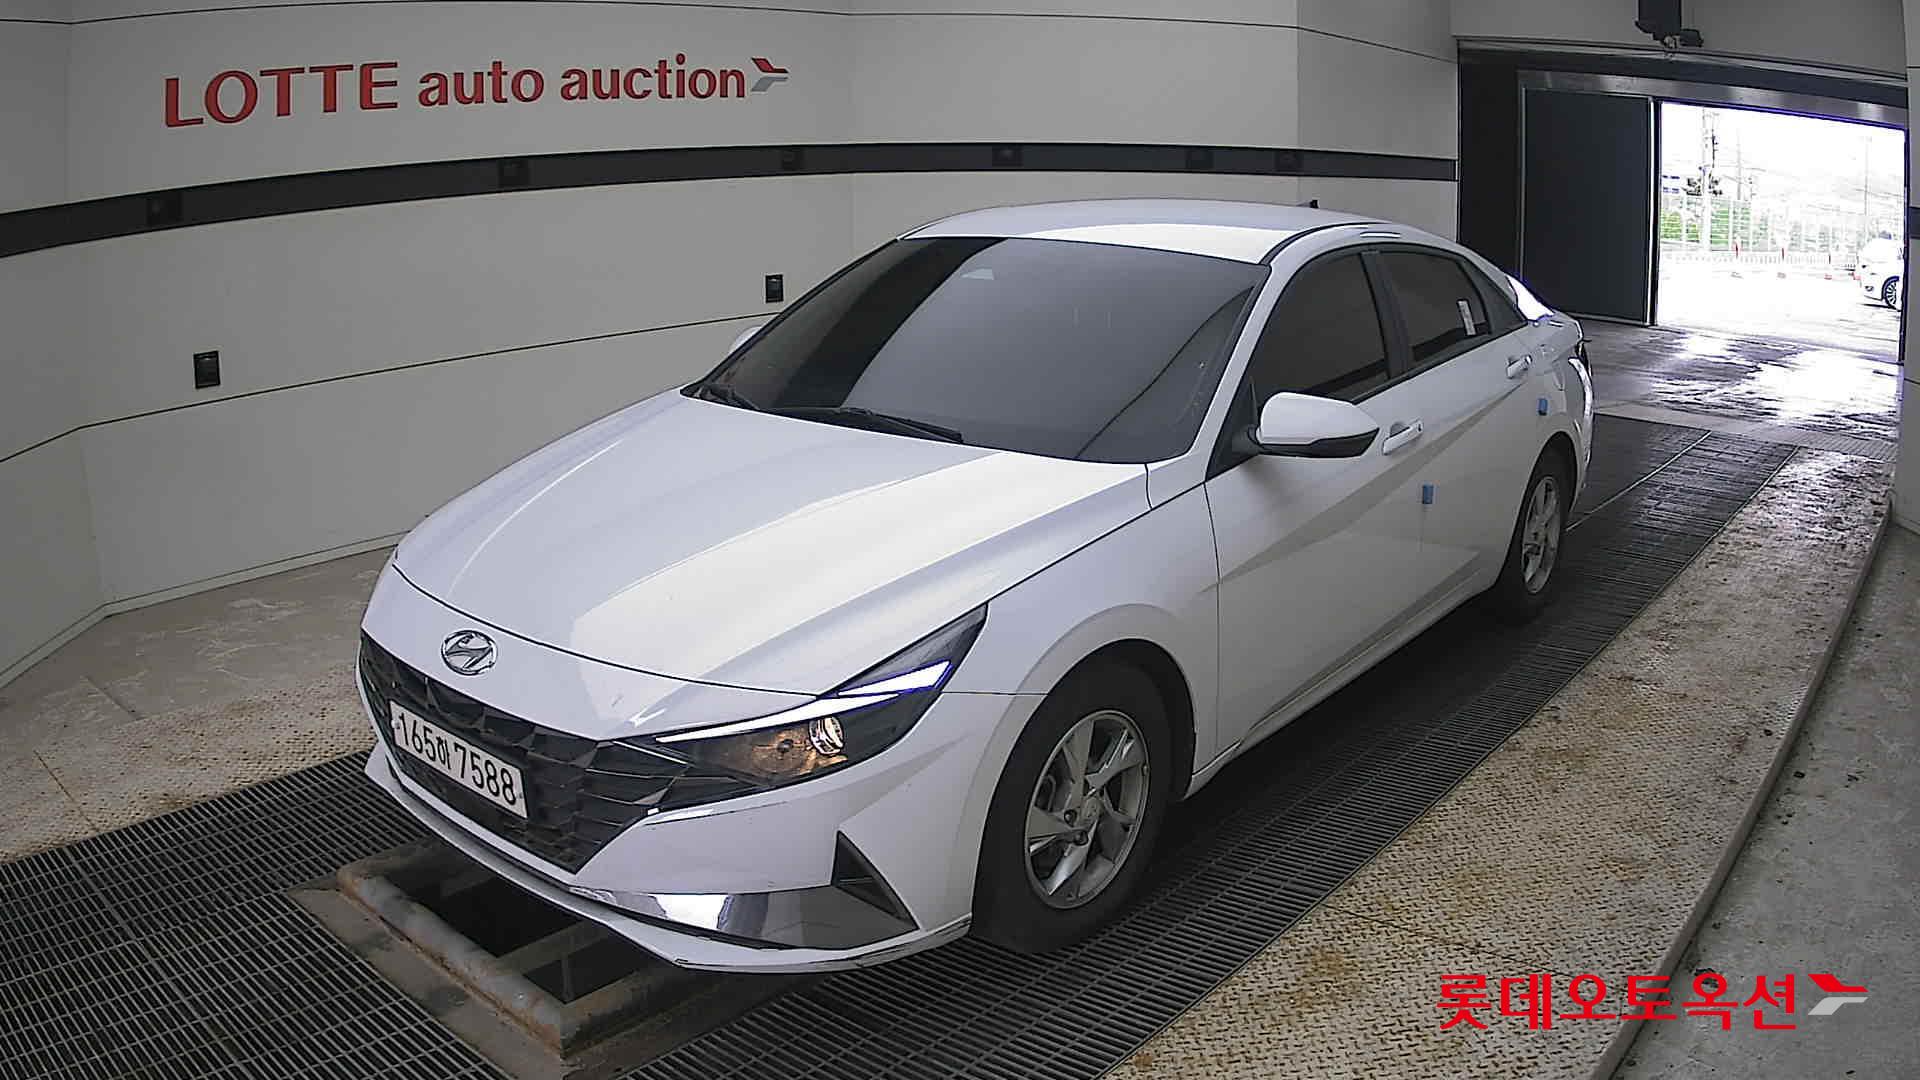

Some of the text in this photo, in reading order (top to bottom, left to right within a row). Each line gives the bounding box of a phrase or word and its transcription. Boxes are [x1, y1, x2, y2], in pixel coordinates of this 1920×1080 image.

[165, 53, 746, 127] LOTTE auto auction
[454, 742, 517, 806] 7588
